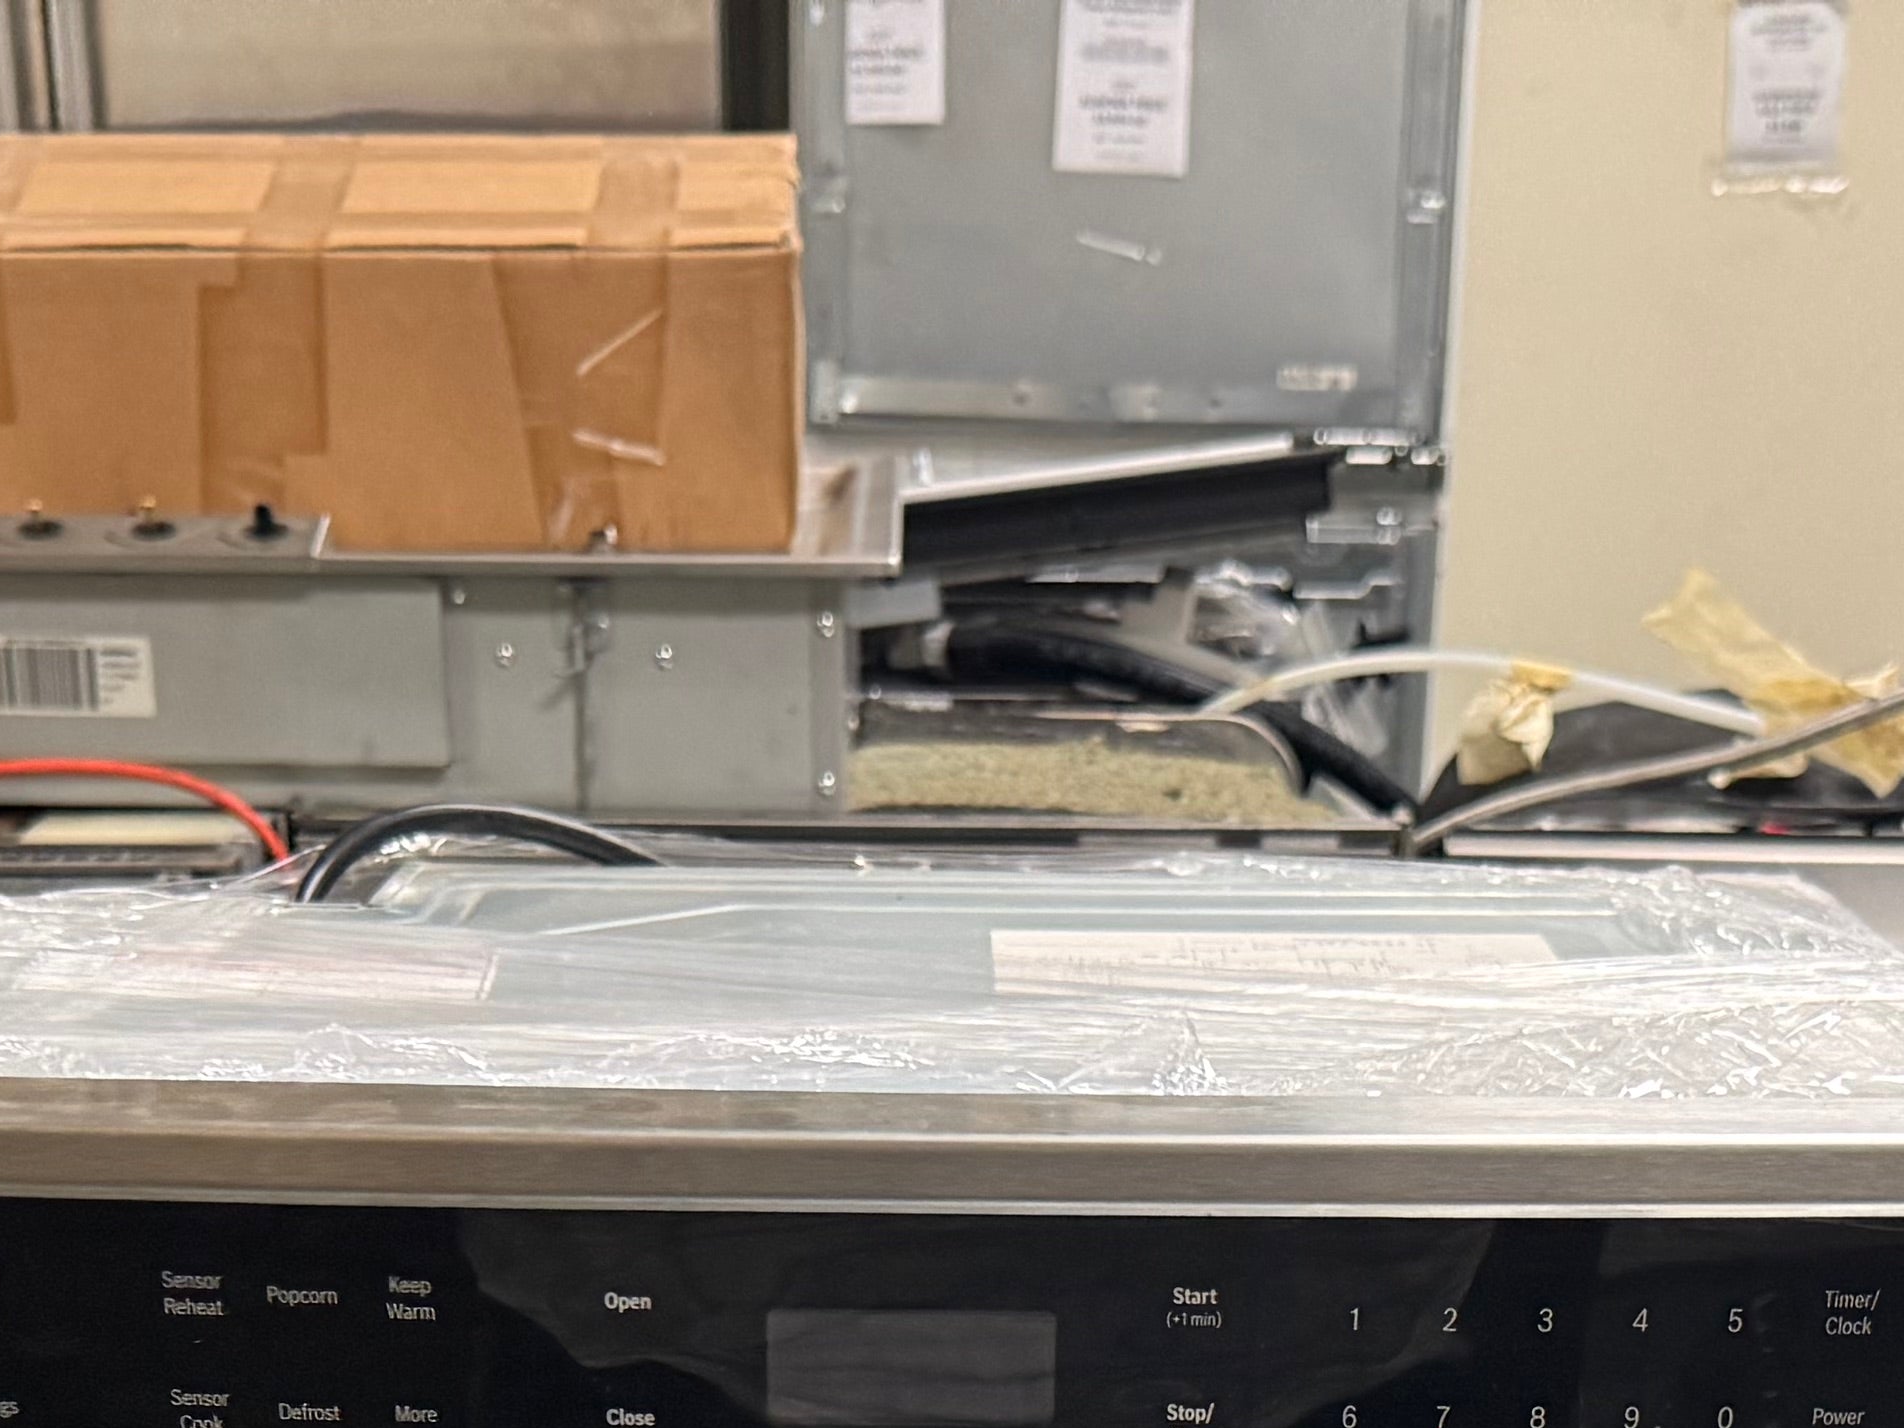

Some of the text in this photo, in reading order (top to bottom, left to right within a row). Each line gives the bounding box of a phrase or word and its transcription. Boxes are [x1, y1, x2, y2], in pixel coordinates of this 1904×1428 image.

[161, 1271, 223, 1289] Sensor
[388, 1276, 432, 1297] Keep
[266, 1286, 338, 1307] Popcorn
[604, 1292, 652, 1313] Open
[1173, 1287, 1218, 1305] Start
[1825, 1289, 1881, 1310] Timer/
[163, 1298, 225, 1316] Reheat
[386, 1303, 436, 1321] Warm
[1166, 1311, 1222, 1329] (+1 min)
[1350, 1307, 1744, 1333] 1 2 3 4 5
[1825, 1316, 1872, 1335] Clock
[170, 1389, 230, 1407] Sensor
[278, 1402, 343, 1421] Defrost
[395, 1405, 439, 1422] More
[606, 1407, 656, 1426] Close
[1166, 1402, 1215, 1424] Stop/
[1342, 1405, 1357, 1428] 6
[1812, 1408, 1865, 1426] Power
